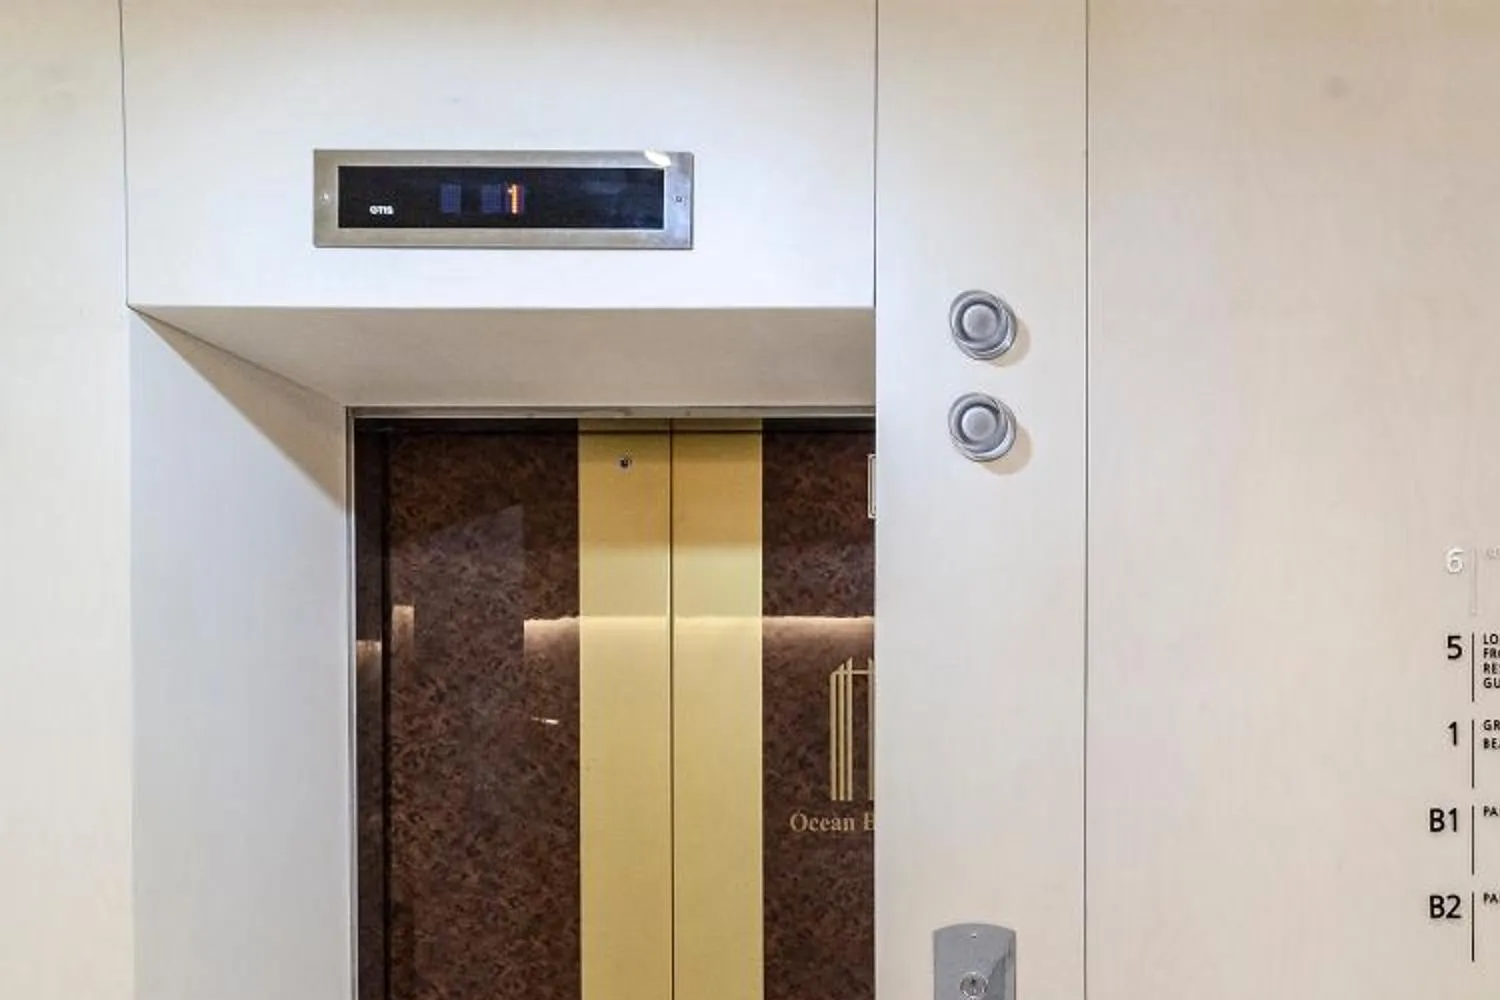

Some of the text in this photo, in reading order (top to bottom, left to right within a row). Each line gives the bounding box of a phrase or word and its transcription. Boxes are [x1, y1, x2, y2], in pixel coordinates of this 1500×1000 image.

[370, 206, 393, 214] OTIS
[508, 184, 518, 214] 1
[1447, 548, 1463, 572] 6
[1448, 635, 1462, 660] 5
[1449, 722, 1457, 746] 1
[789, 813, 855, 832] Ocean
[1430, 808, 1457, 832] B1
[1430, 894, 1461, 919] B2
